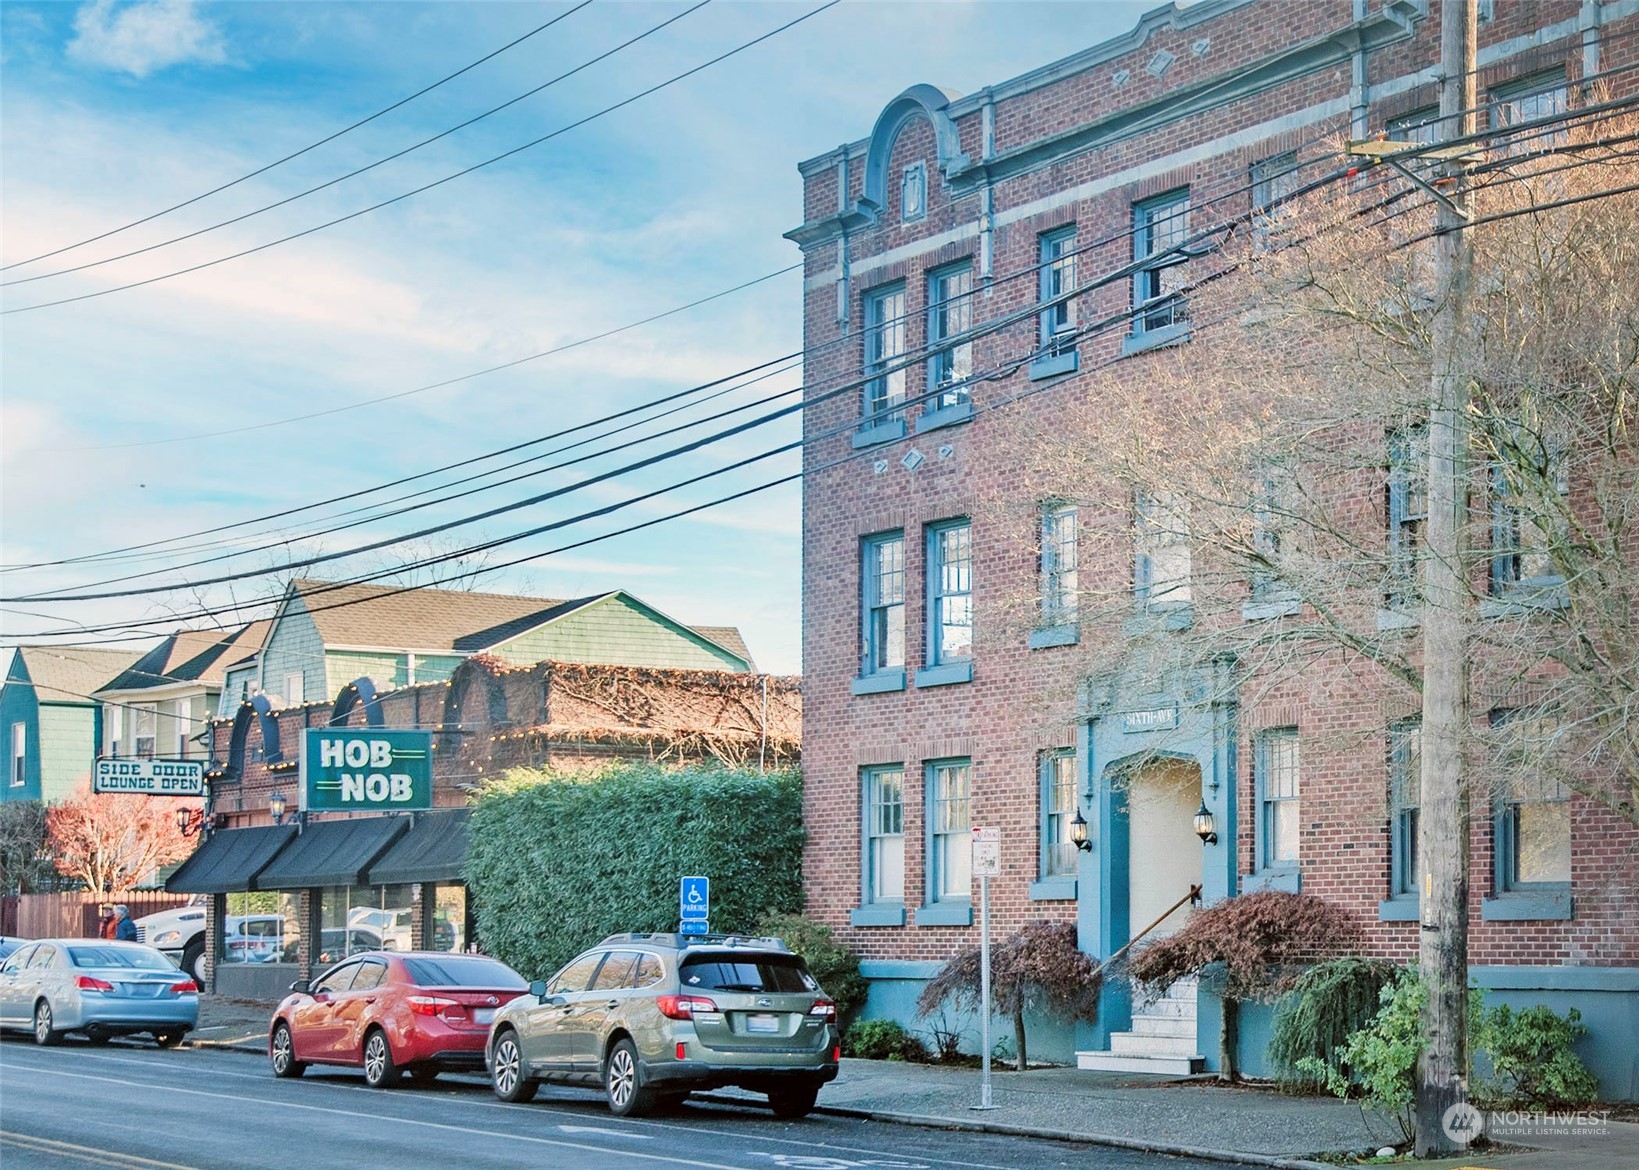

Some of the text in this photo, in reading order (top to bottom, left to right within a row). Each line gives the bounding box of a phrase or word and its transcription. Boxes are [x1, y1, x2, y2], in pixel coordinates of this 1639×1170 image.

[320, 739, 393, 768] HOB
[100, 764, 199, 777] SIDE DOOR
[101, 777, 199, 790] LOUNGE OPEN
[341, 773, 413, 802] NOB
[683, 904, 707, 912] PARKING
